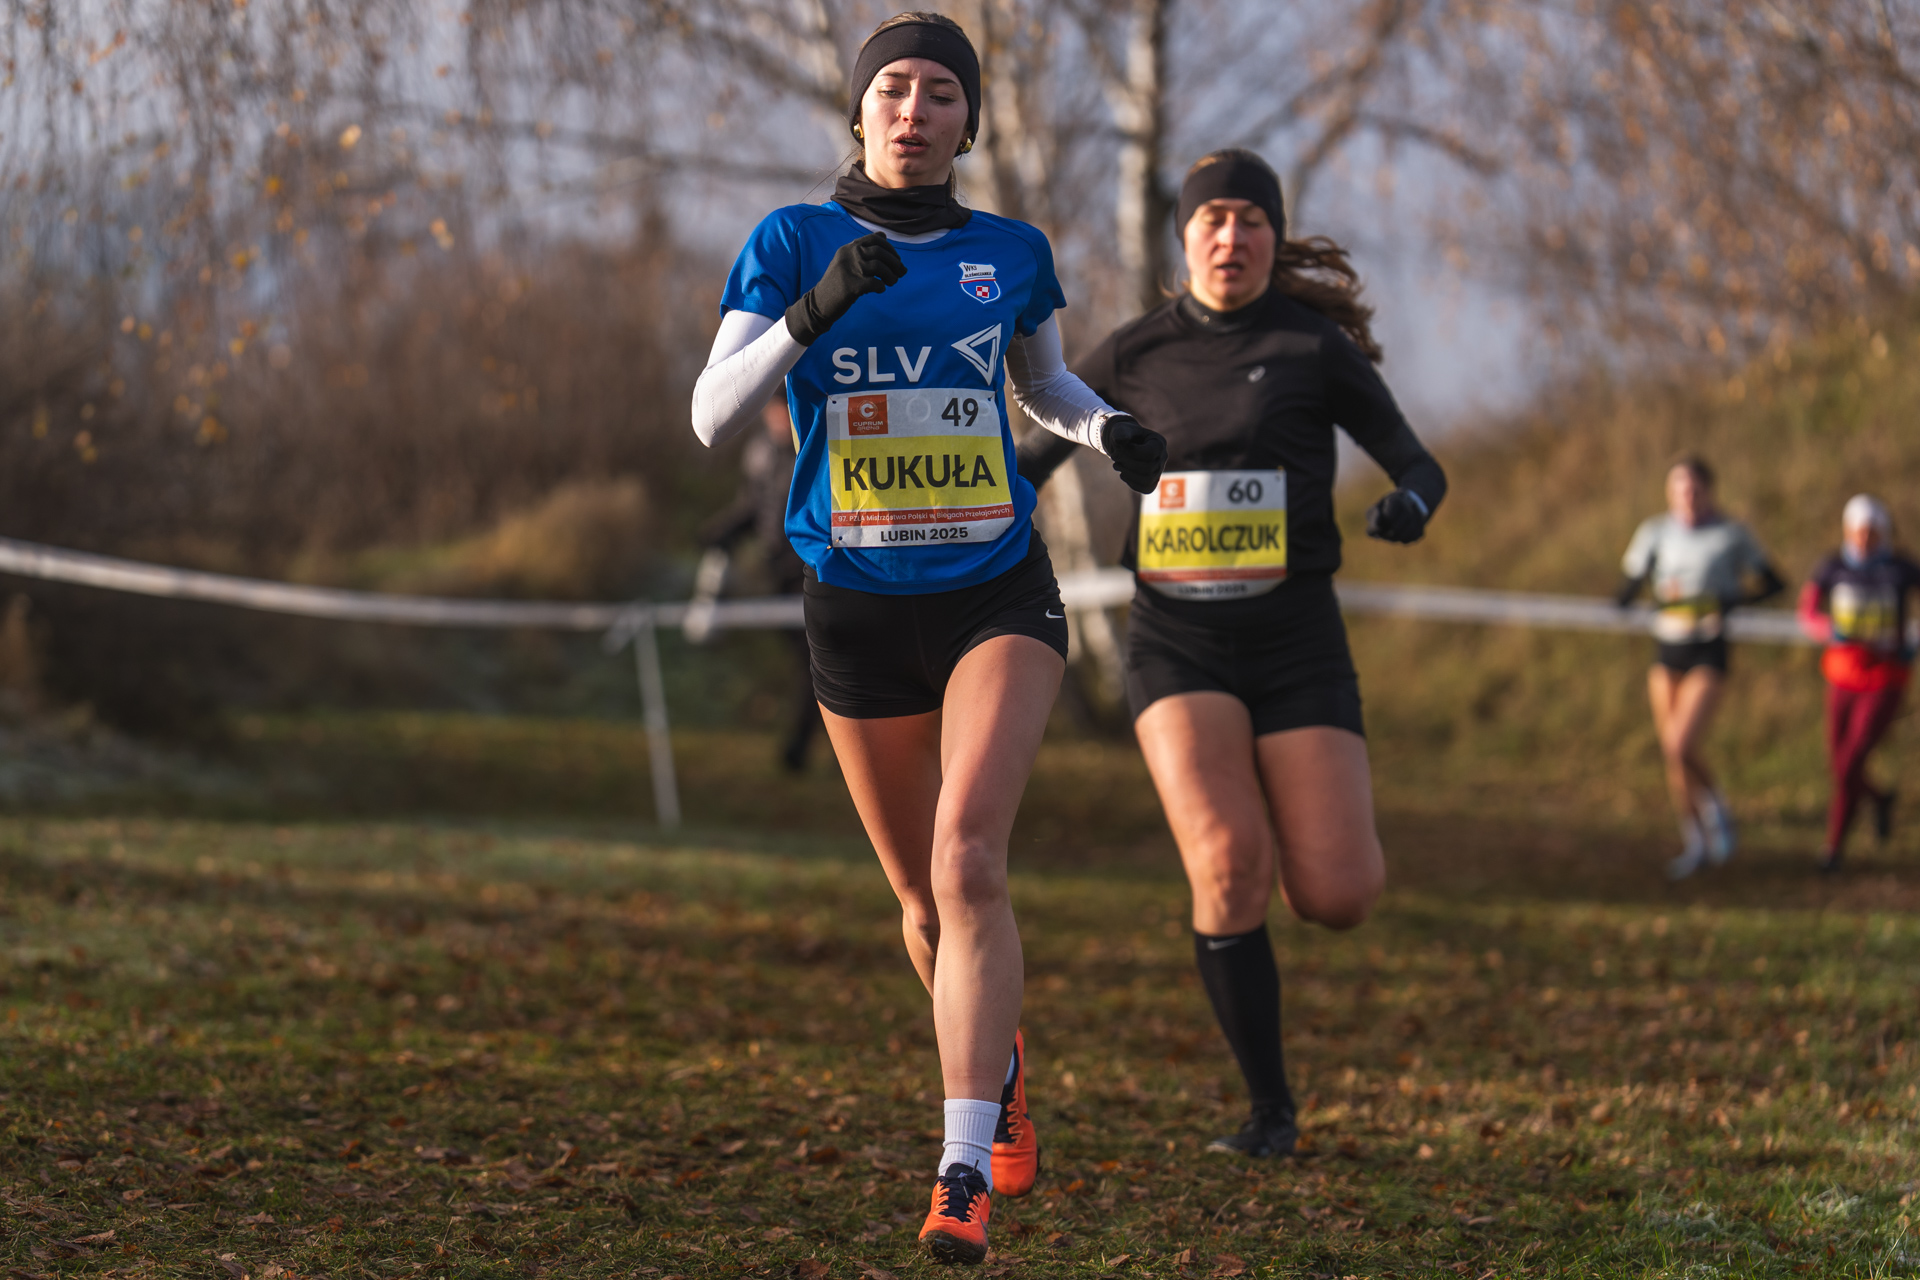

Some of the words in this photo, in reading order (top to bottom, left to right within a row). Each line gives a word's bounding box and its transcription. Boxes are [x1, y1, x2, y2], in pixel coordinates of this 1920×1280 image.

[832, 346, 932, 385] SLV
[941, 397, 979, 427] 49
[843, 454, 997, 492] KUKUŁA
[1228, 478, 1264, 504] 60
[908, 512, 928, 520] Polski
[936, 511, 964, 520] Biegach
[880, 529, 926, 542] LUBIN
[929, 527, 969, 540] 2025
[1146, 524, 1280, 553] KAROLCZUK
